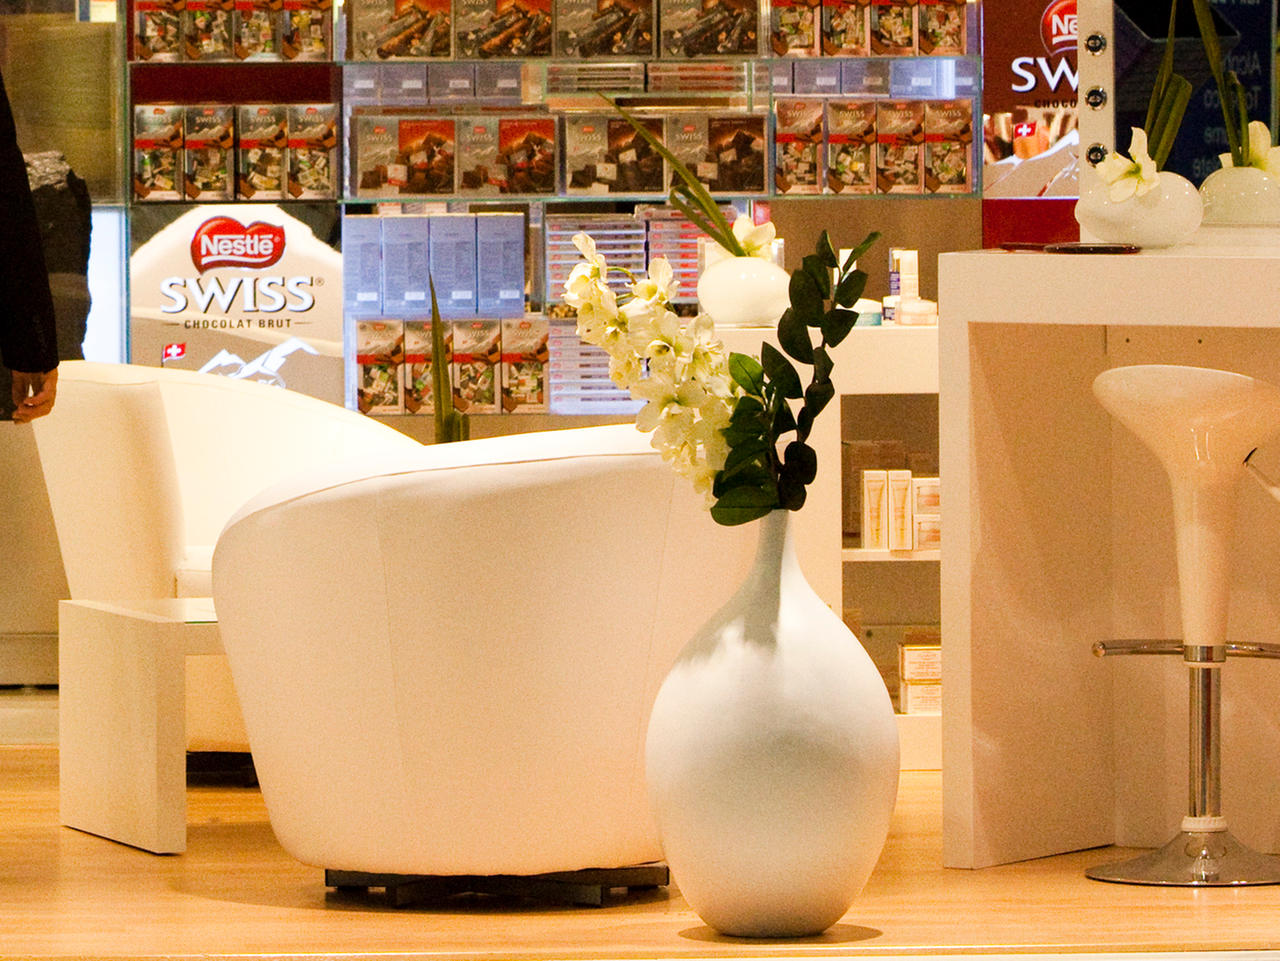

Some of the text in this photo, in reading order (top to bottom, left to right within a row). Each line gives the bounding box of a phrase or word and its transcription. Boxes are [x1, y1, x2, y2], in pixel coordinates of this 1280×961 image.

[200, 234, 274, 257] Nestlé
[159, 276, 316, 314] SWISS
[184, 318, 292, 329] CHOCOLAT BRUT
